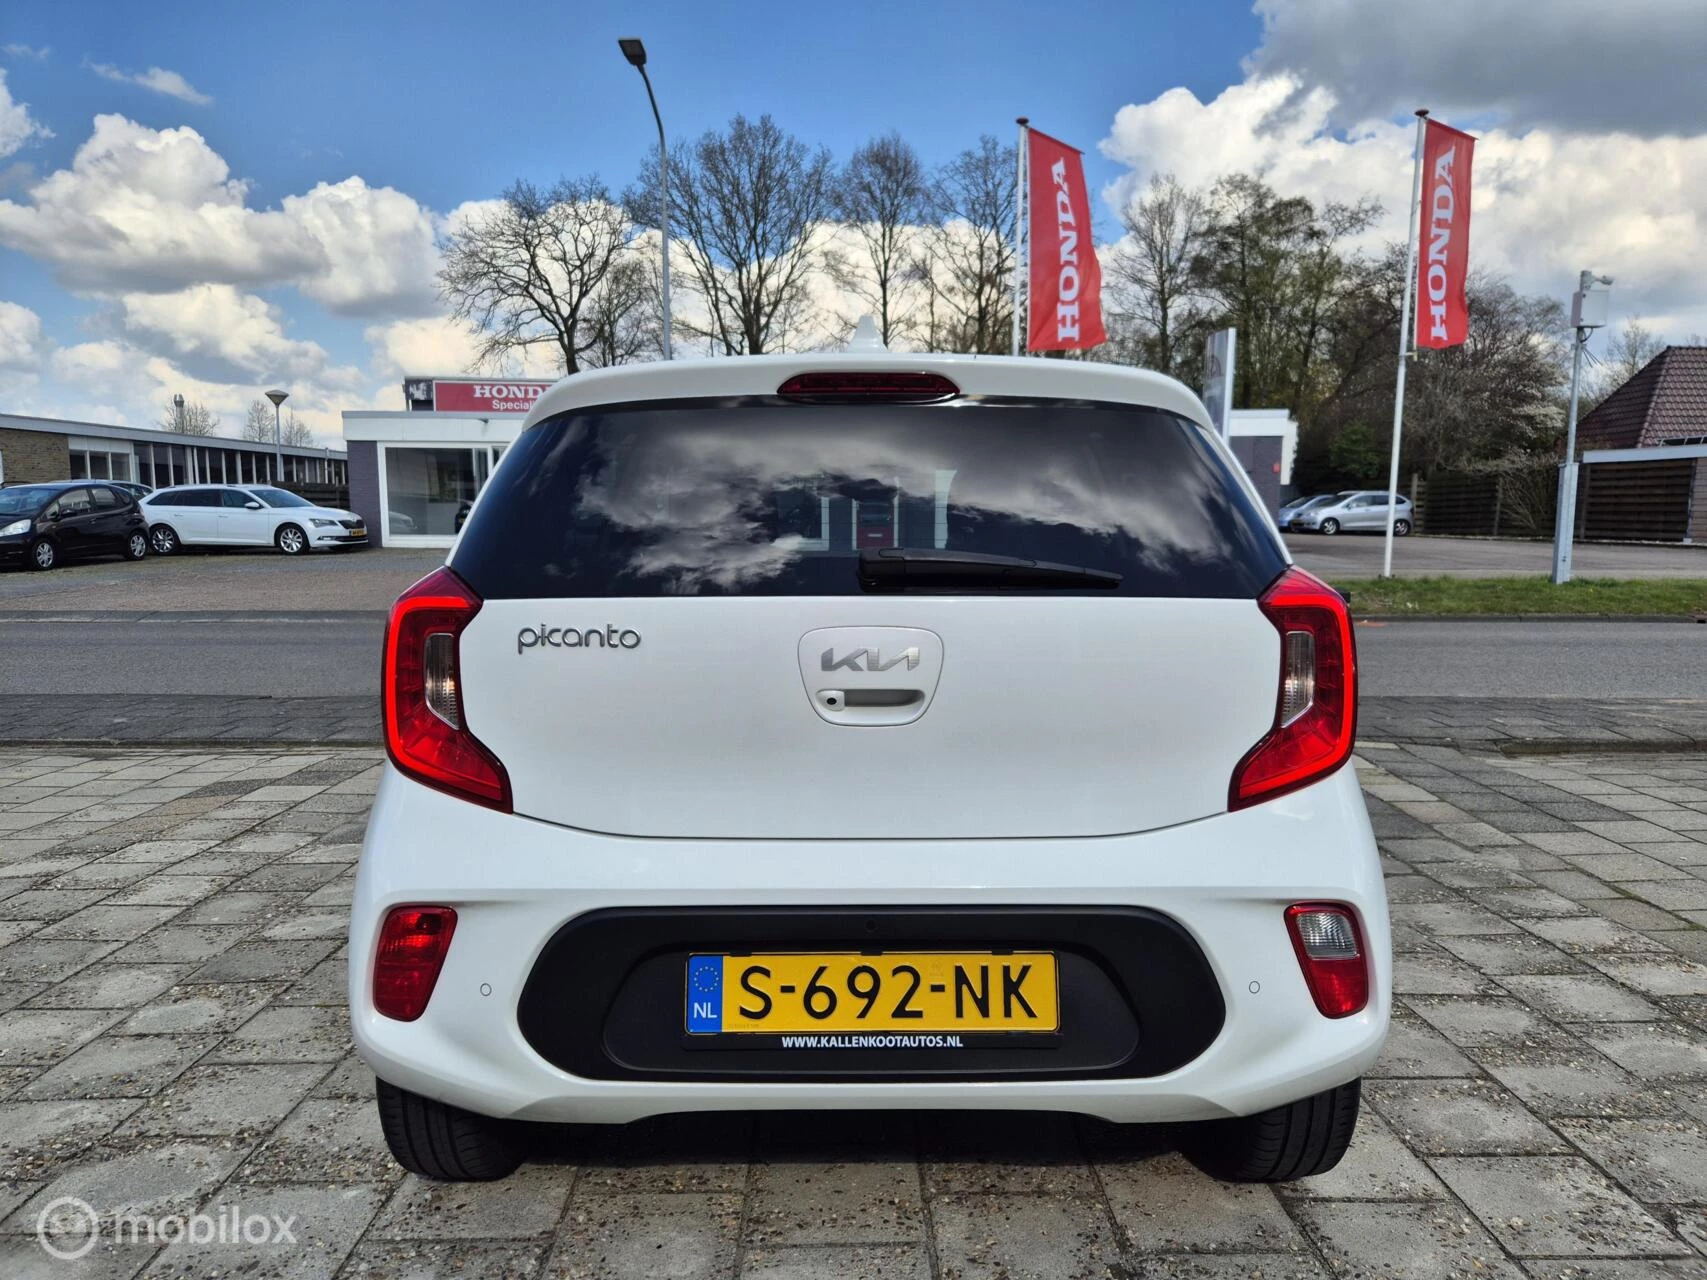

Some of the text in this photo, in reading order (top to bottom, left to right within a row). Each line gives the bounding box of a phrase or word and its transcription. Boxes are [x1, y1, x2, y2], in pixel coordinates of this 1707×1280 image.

[1051, 157, 1080, 342] HONDA
[1427, 145, 1456, 341] HONDA
[492, 399, 535, 411] Special
[518, 624, 641, 655] picanto
[821, 647, 920, 672] KIA
[693, 965, 1038, 1019] NL S-692-NK
[781, 1035, 964, 1048] WWW.KALLENKOOTAUTOS.NL
